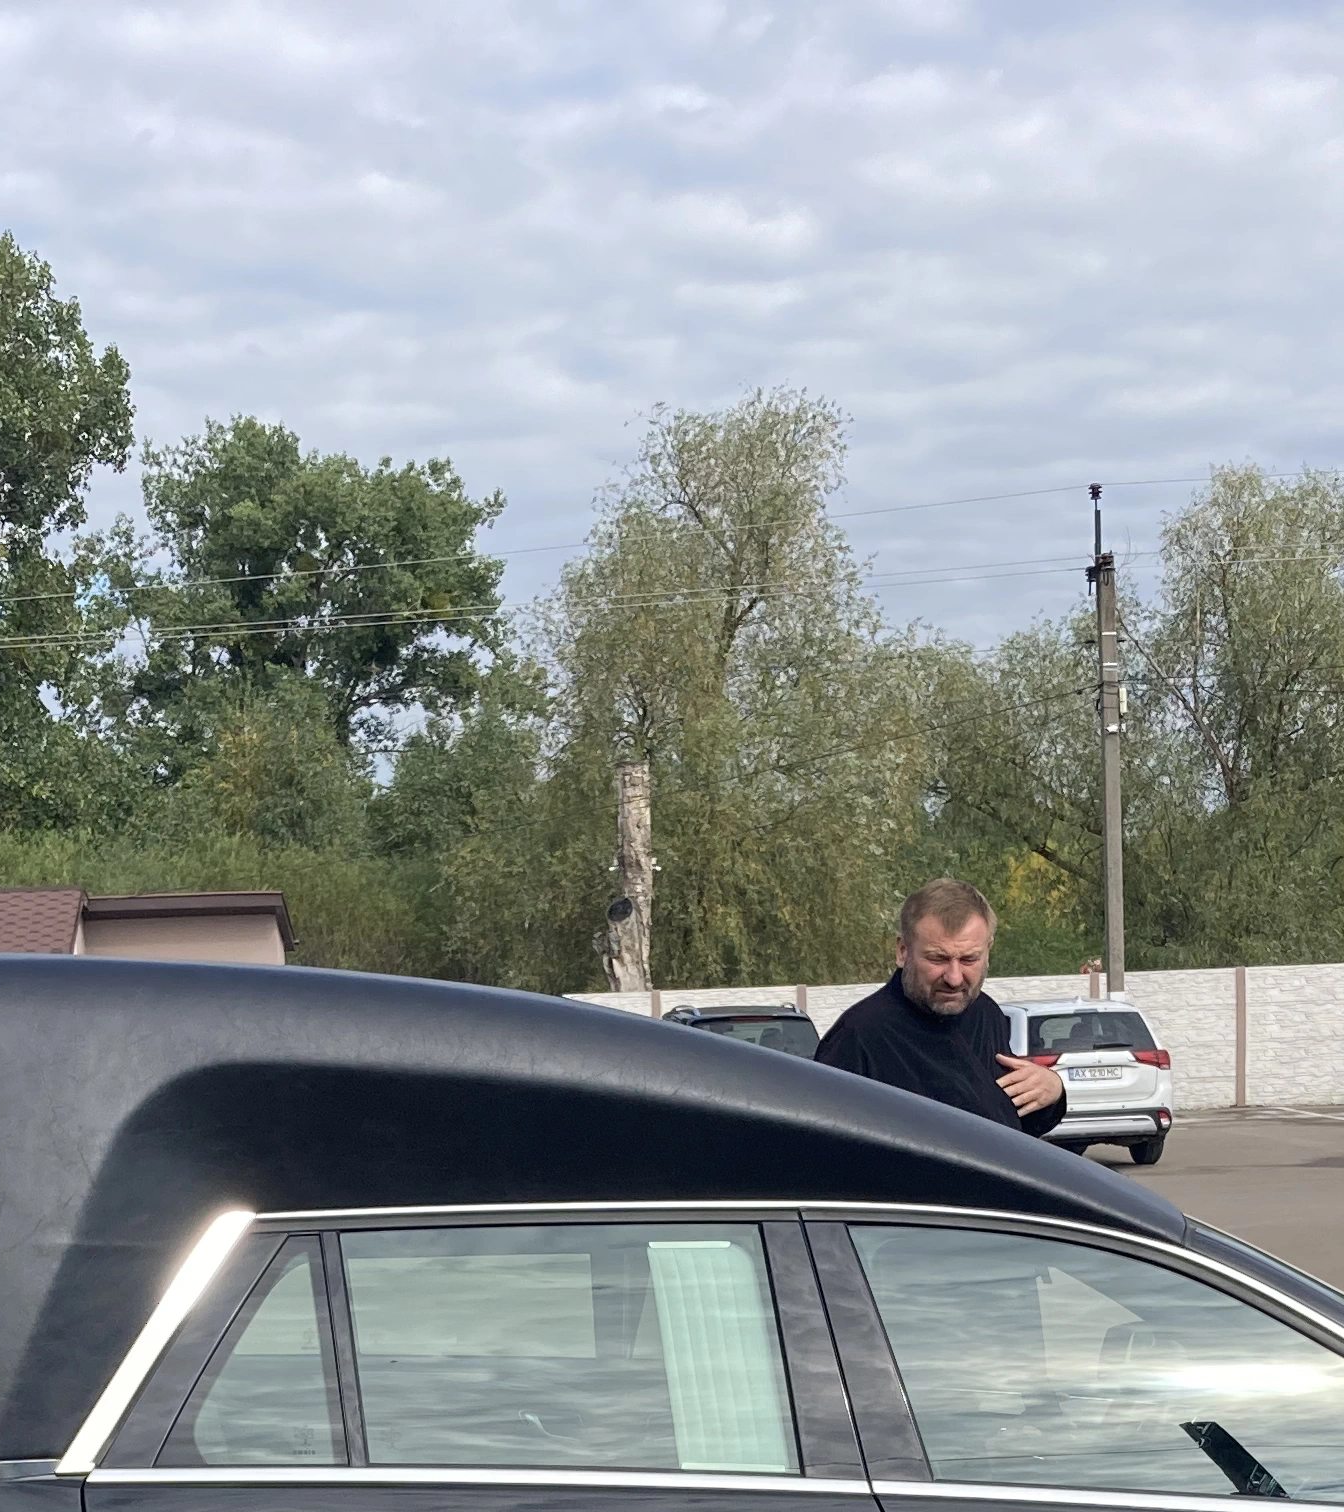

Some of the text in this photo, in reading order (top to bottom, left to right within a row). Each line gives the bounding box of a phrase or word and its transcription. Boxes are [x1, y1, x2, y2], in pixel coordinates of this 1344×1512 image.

[1074, 1068, 1119, 1078] AX 1210 MC
